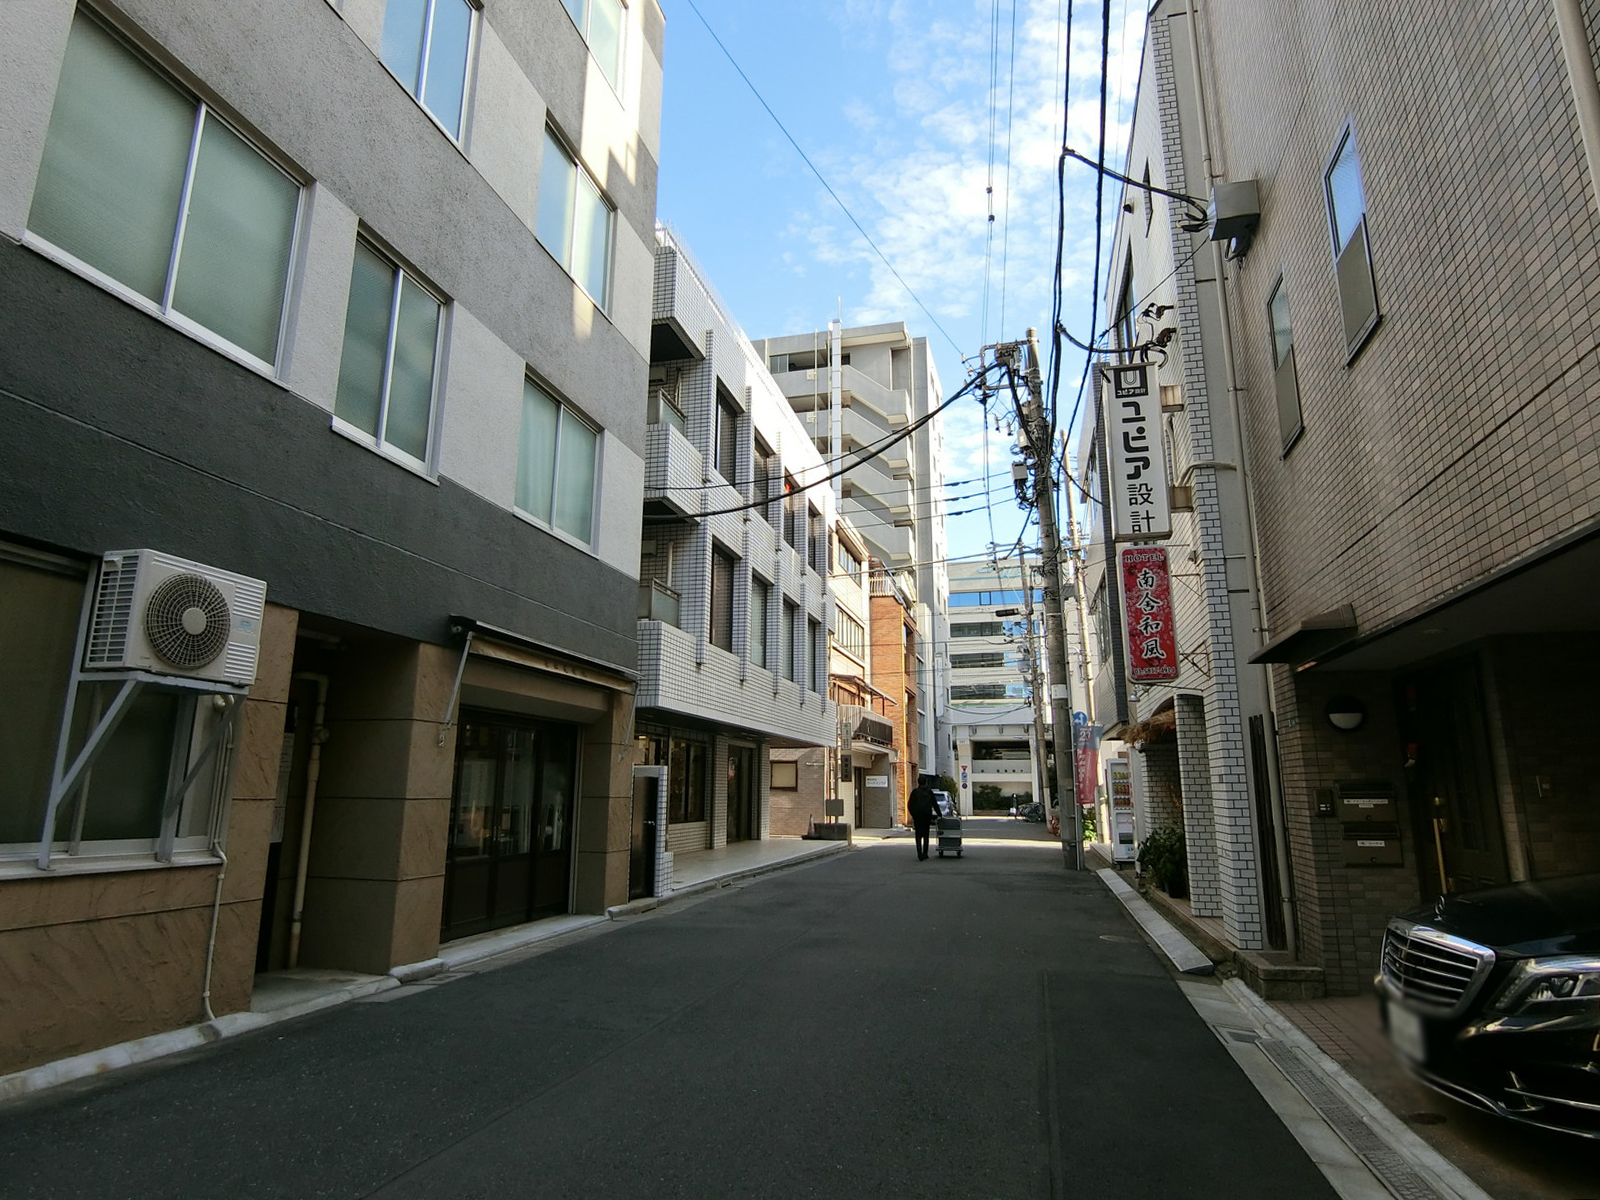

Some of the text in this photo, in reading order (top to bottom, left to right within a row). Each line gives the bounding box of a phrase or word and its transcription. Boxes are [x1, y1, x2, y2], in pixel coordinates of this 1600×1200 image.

[1117, 388, 1146, 396] ユピア設計
[1122, 401, 1155, 533] ユピア設計
[1125, 554, 1165, 563] HOTEL
